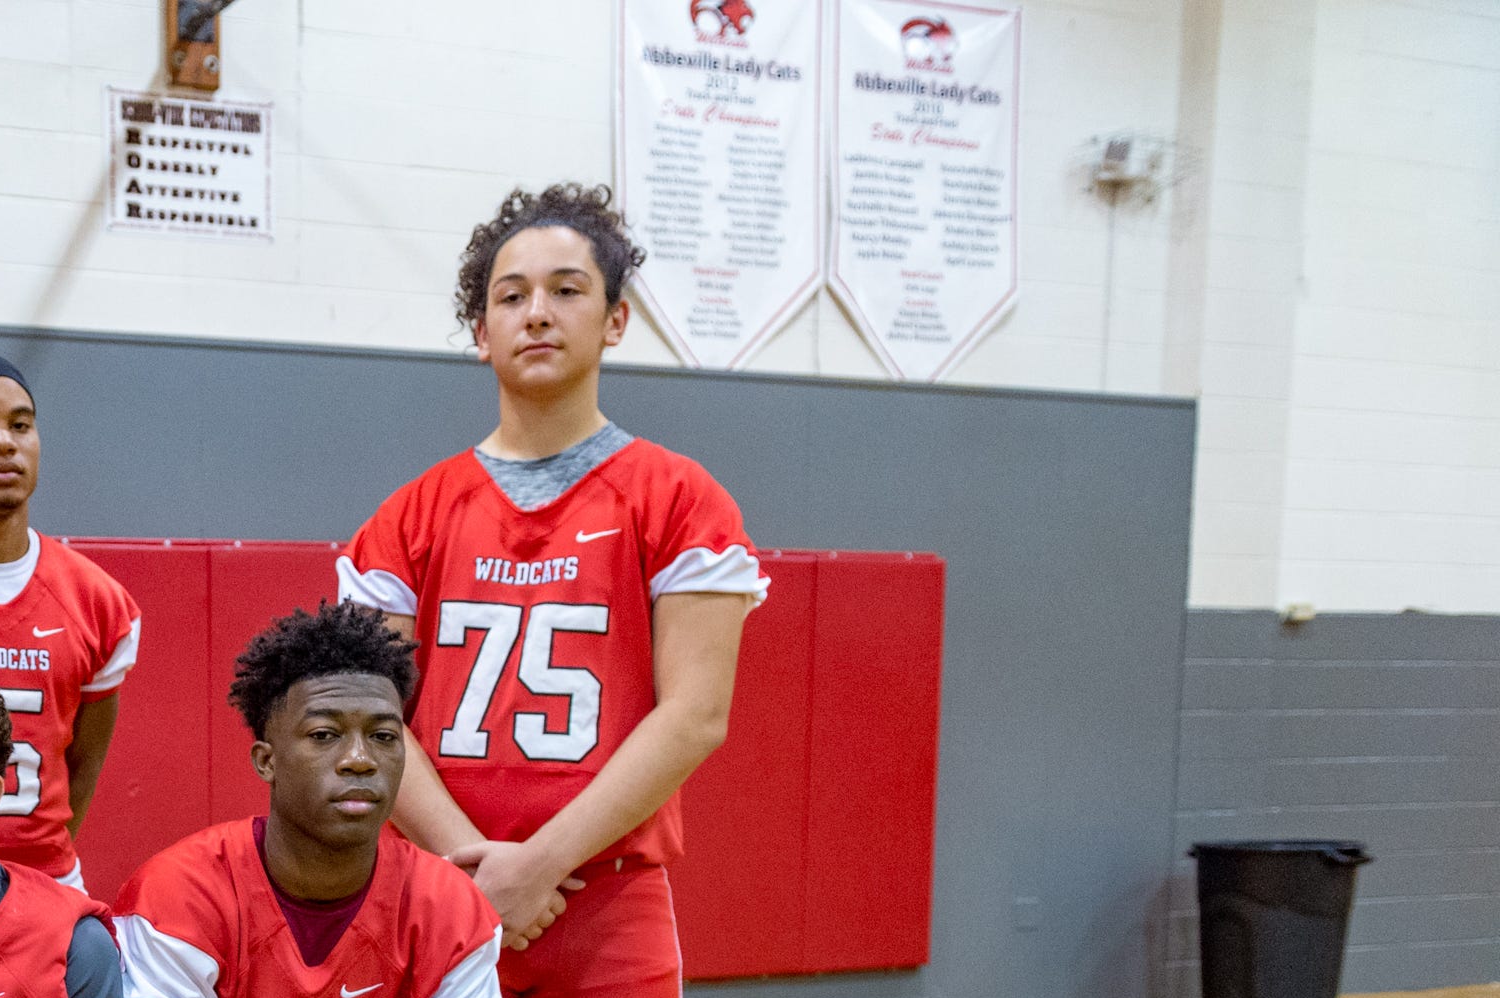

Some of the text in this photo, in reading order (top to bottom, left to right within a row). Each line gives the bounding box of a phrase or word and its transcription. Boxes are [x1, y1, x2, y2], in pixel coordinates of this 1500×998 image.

[643, 44, 802, 81] Abbeville Lady Cats
[854, 72, 1002, 105] Abbeville Lady Cats
[475, 556, 579, 586] WILDCATS
[437, 601, 610, 763] 75
